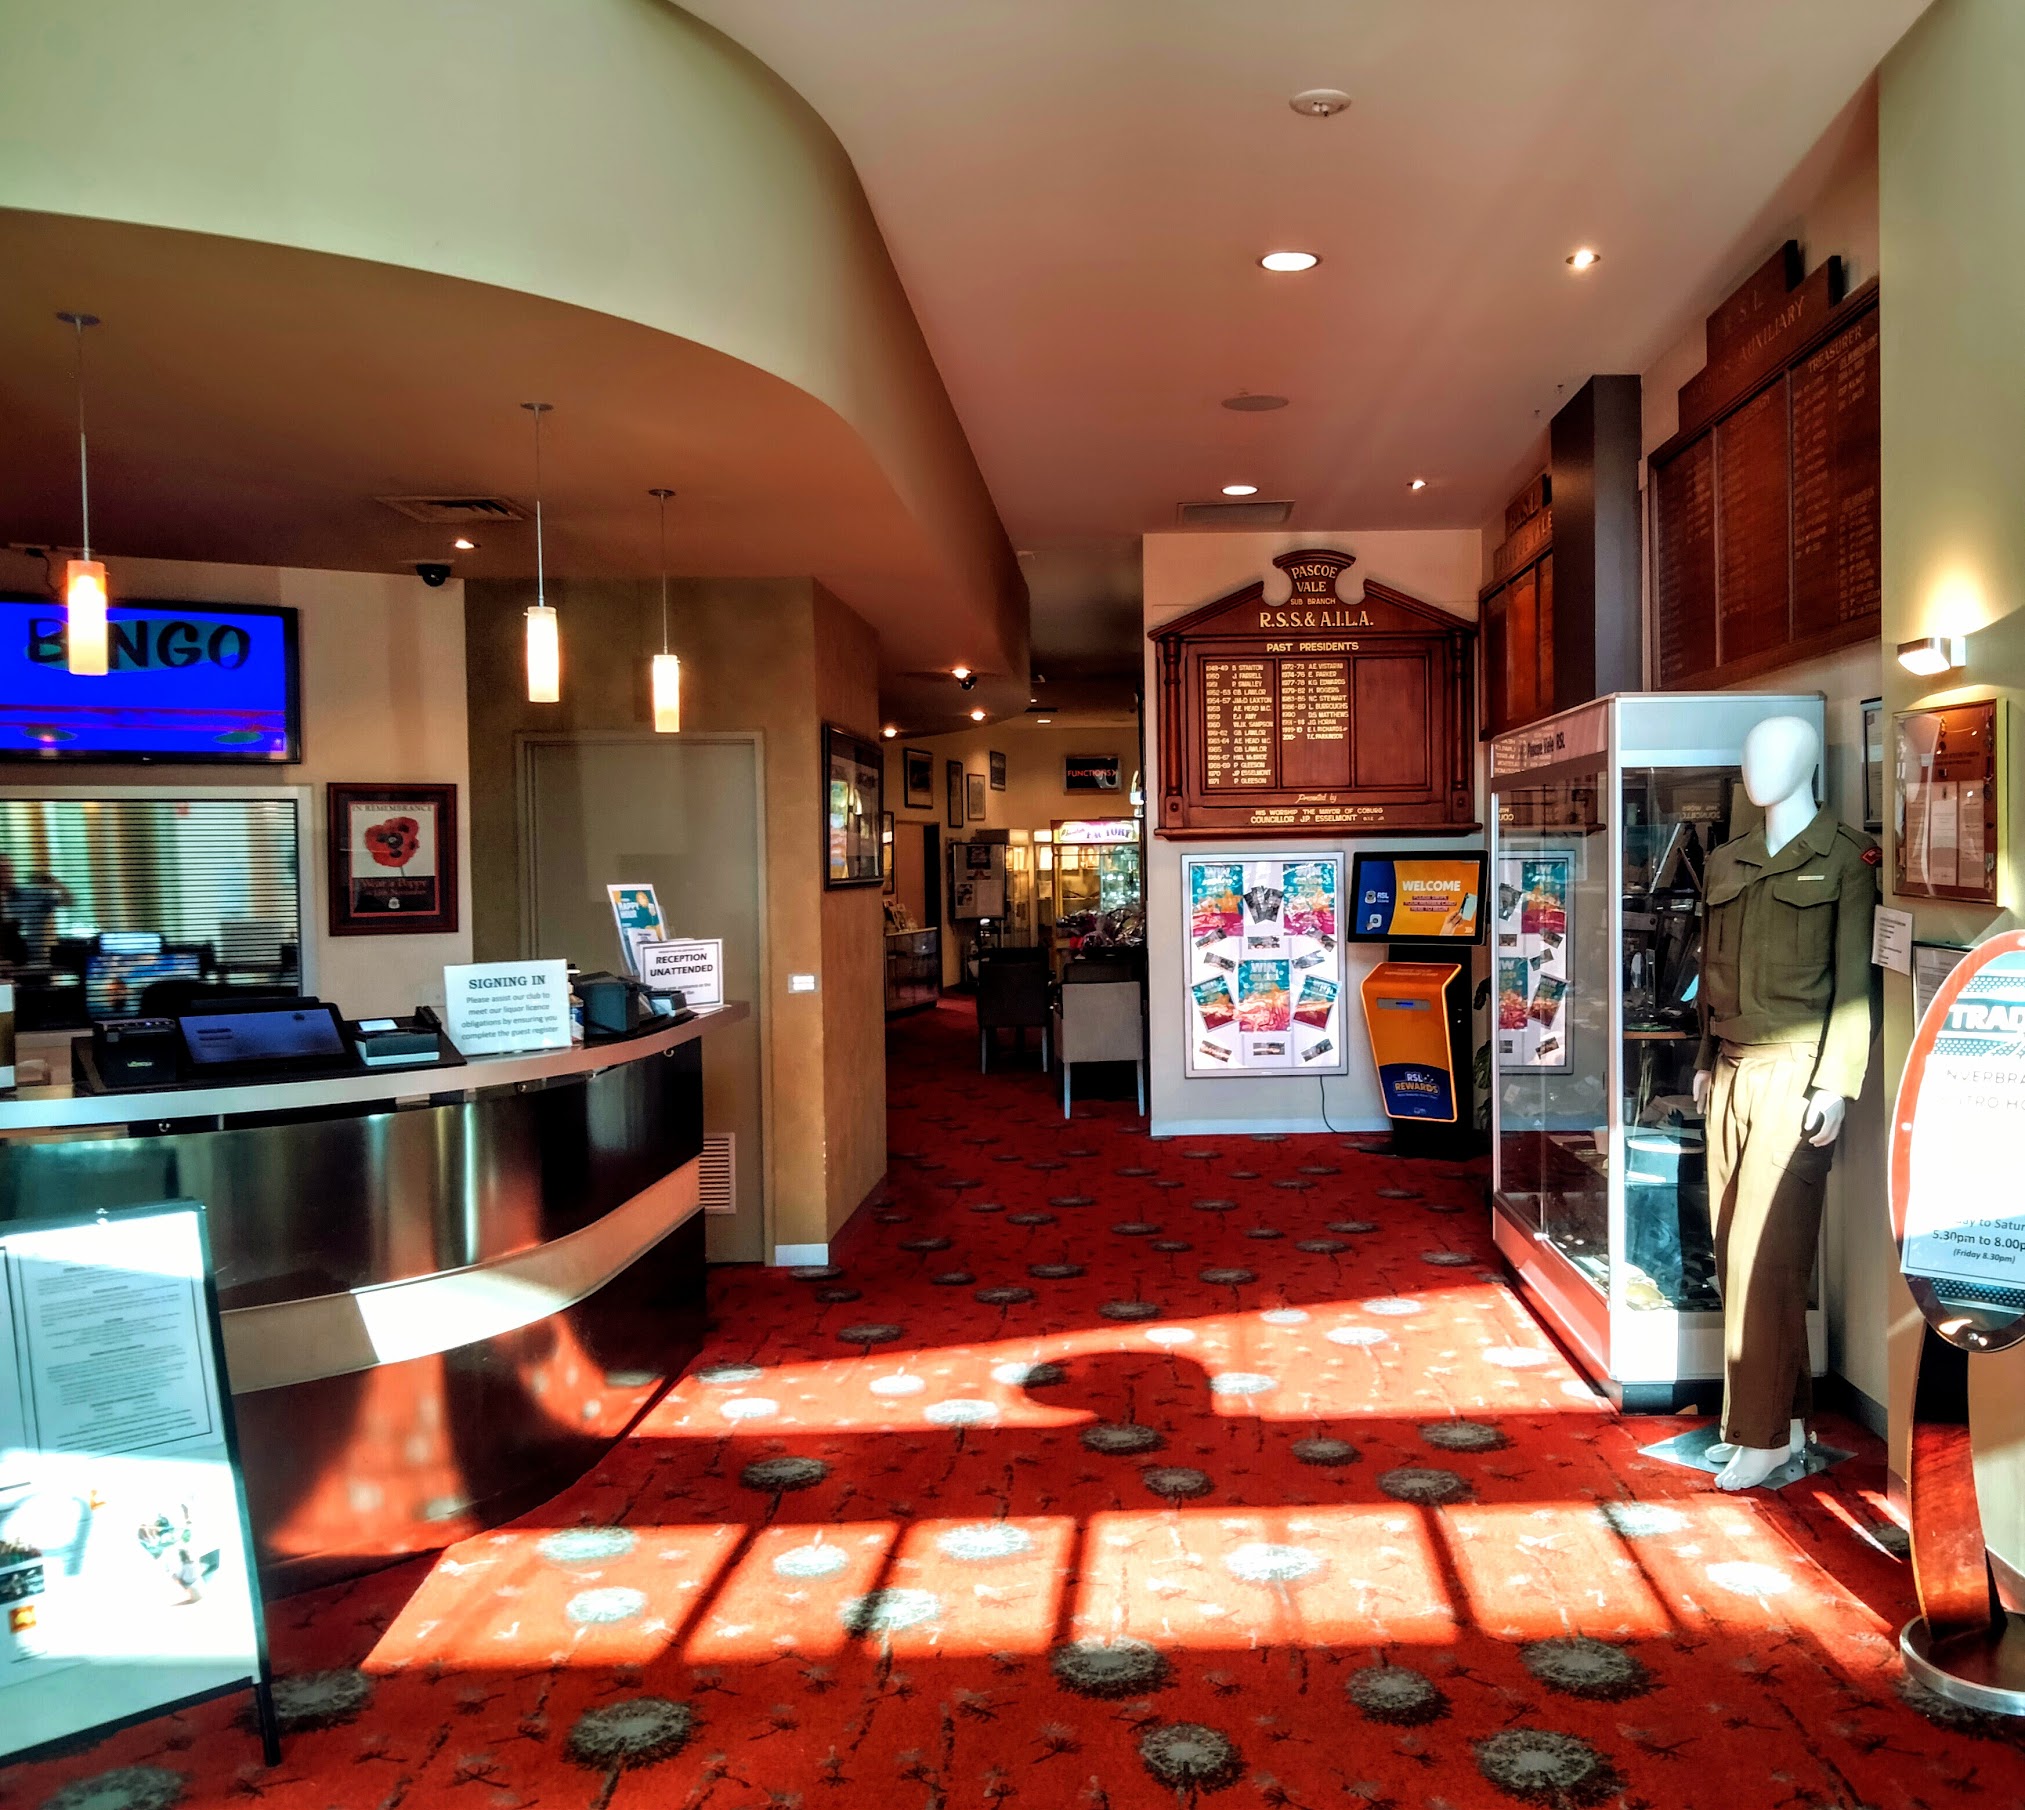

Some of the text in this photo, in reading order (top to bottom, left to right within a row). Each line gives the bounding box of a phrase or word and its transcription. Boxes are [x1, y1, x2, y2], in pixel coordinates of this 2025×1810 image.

[1807, 326, 1862, 374] TREASURER
[1291, 565, 1338, 579] PASCOE
[1296, 581, 1326, 592] VALE
[1320, 611, 1374, 627] A.I.L.A.
[29, 618, 250, 670] BNGO
[1266, 642, 1359, 652] PAST PRESIDENTS
[1067, 769, 1112, 777] FUNCTIONS
[1330, 793, 1337, 803] by
[365, 804, 432, 812] REMEMBRANCE
[1250, 815, 1294, 824] COUNCILLOR
[1315, 814, 1358, 822] ESSELMONT
[1402, 880, 1461, 892] WELCOME
[656, 953, 708, 964] RECEPTION
[650, 964, 714, 976] UNATTENDED
[1251, 963, 1276, 973] WIN
[469, 975, 546, 989] SIGNING IN
[526, 992, 541, 1000] club
[503, 1005, 524, 1014] liquor
[461, 1019, 501, 1028] obligations
[502, 1018, 512, 1026] by
[513, 1015, 544, 1023] ensuring
[461, 1031, 496, 1040] complete
[511, 1028, 530, 1037] guest
[532, 1026, 558, 1034] register
[1406, 1073, 1422, 1083] RSL
[1394, 1081, 1438, 1095] REWARDS
[1979, 1219, 1991, 1227] to
[1932, 1230, 1975, 1244] 5.30pm
[1979, 1235, 1991, 1246] to
[1953, 1249, 2016, 1264] (Friday 8.30pm)
